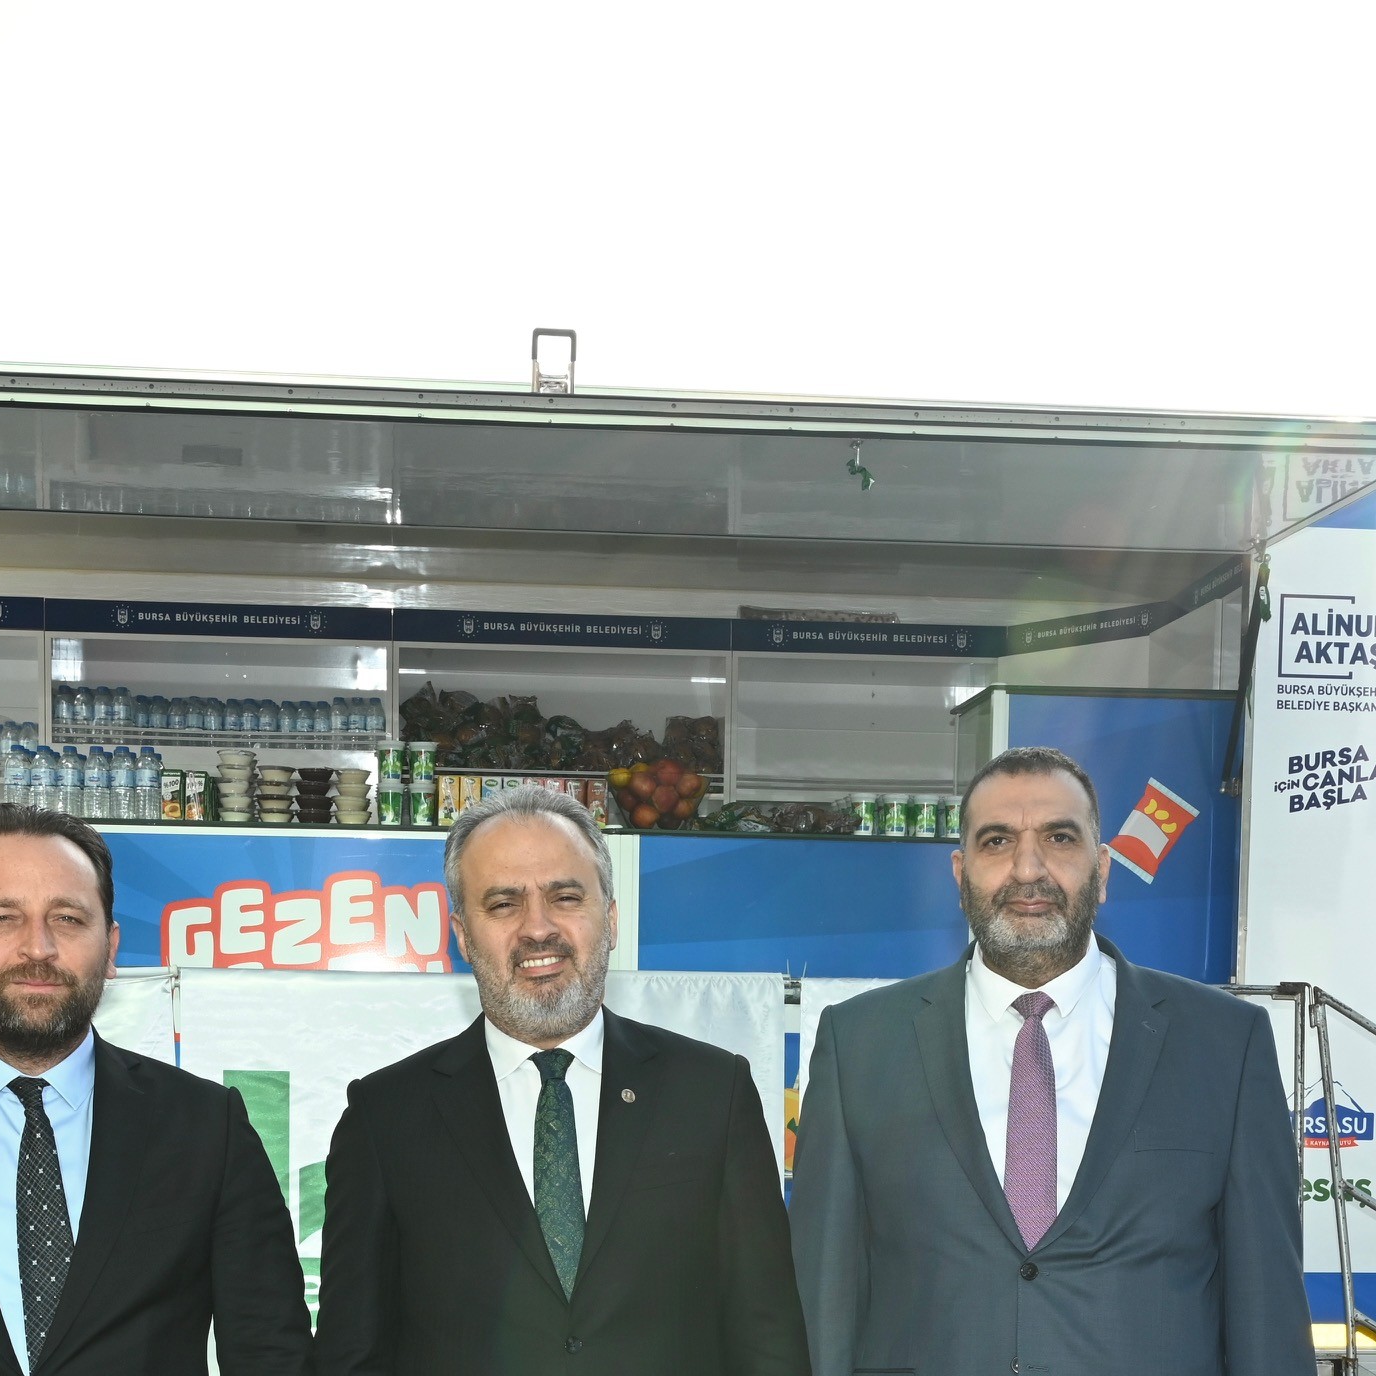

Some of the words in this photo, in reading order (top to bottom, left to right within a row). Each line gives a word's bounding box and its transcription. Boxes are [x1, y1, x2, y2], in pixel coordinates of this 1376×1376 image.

[138, 612, 171, 622] BURSA
[175, 612, 238, 626] BÜYÜKŞEHİR
[242, 614, 302, 626] BELEDİYESİ
[483, 622, 516, 632] BURSA
[586, 624, 642, 636] BELEDİYESİ
[792, 631, 825, 641] BURSA
[892, 632, 948, 645] BELEDİYESİ
[1277, 684, 1314, 696] BURSA
[1276, 698, 1330, 712] BELEDİYE
[1288, 744, 1370, 774] BURSA
[1289, 784, 1368, 813] BAŞLA
[168, 879, 441, 968] GEZEN
